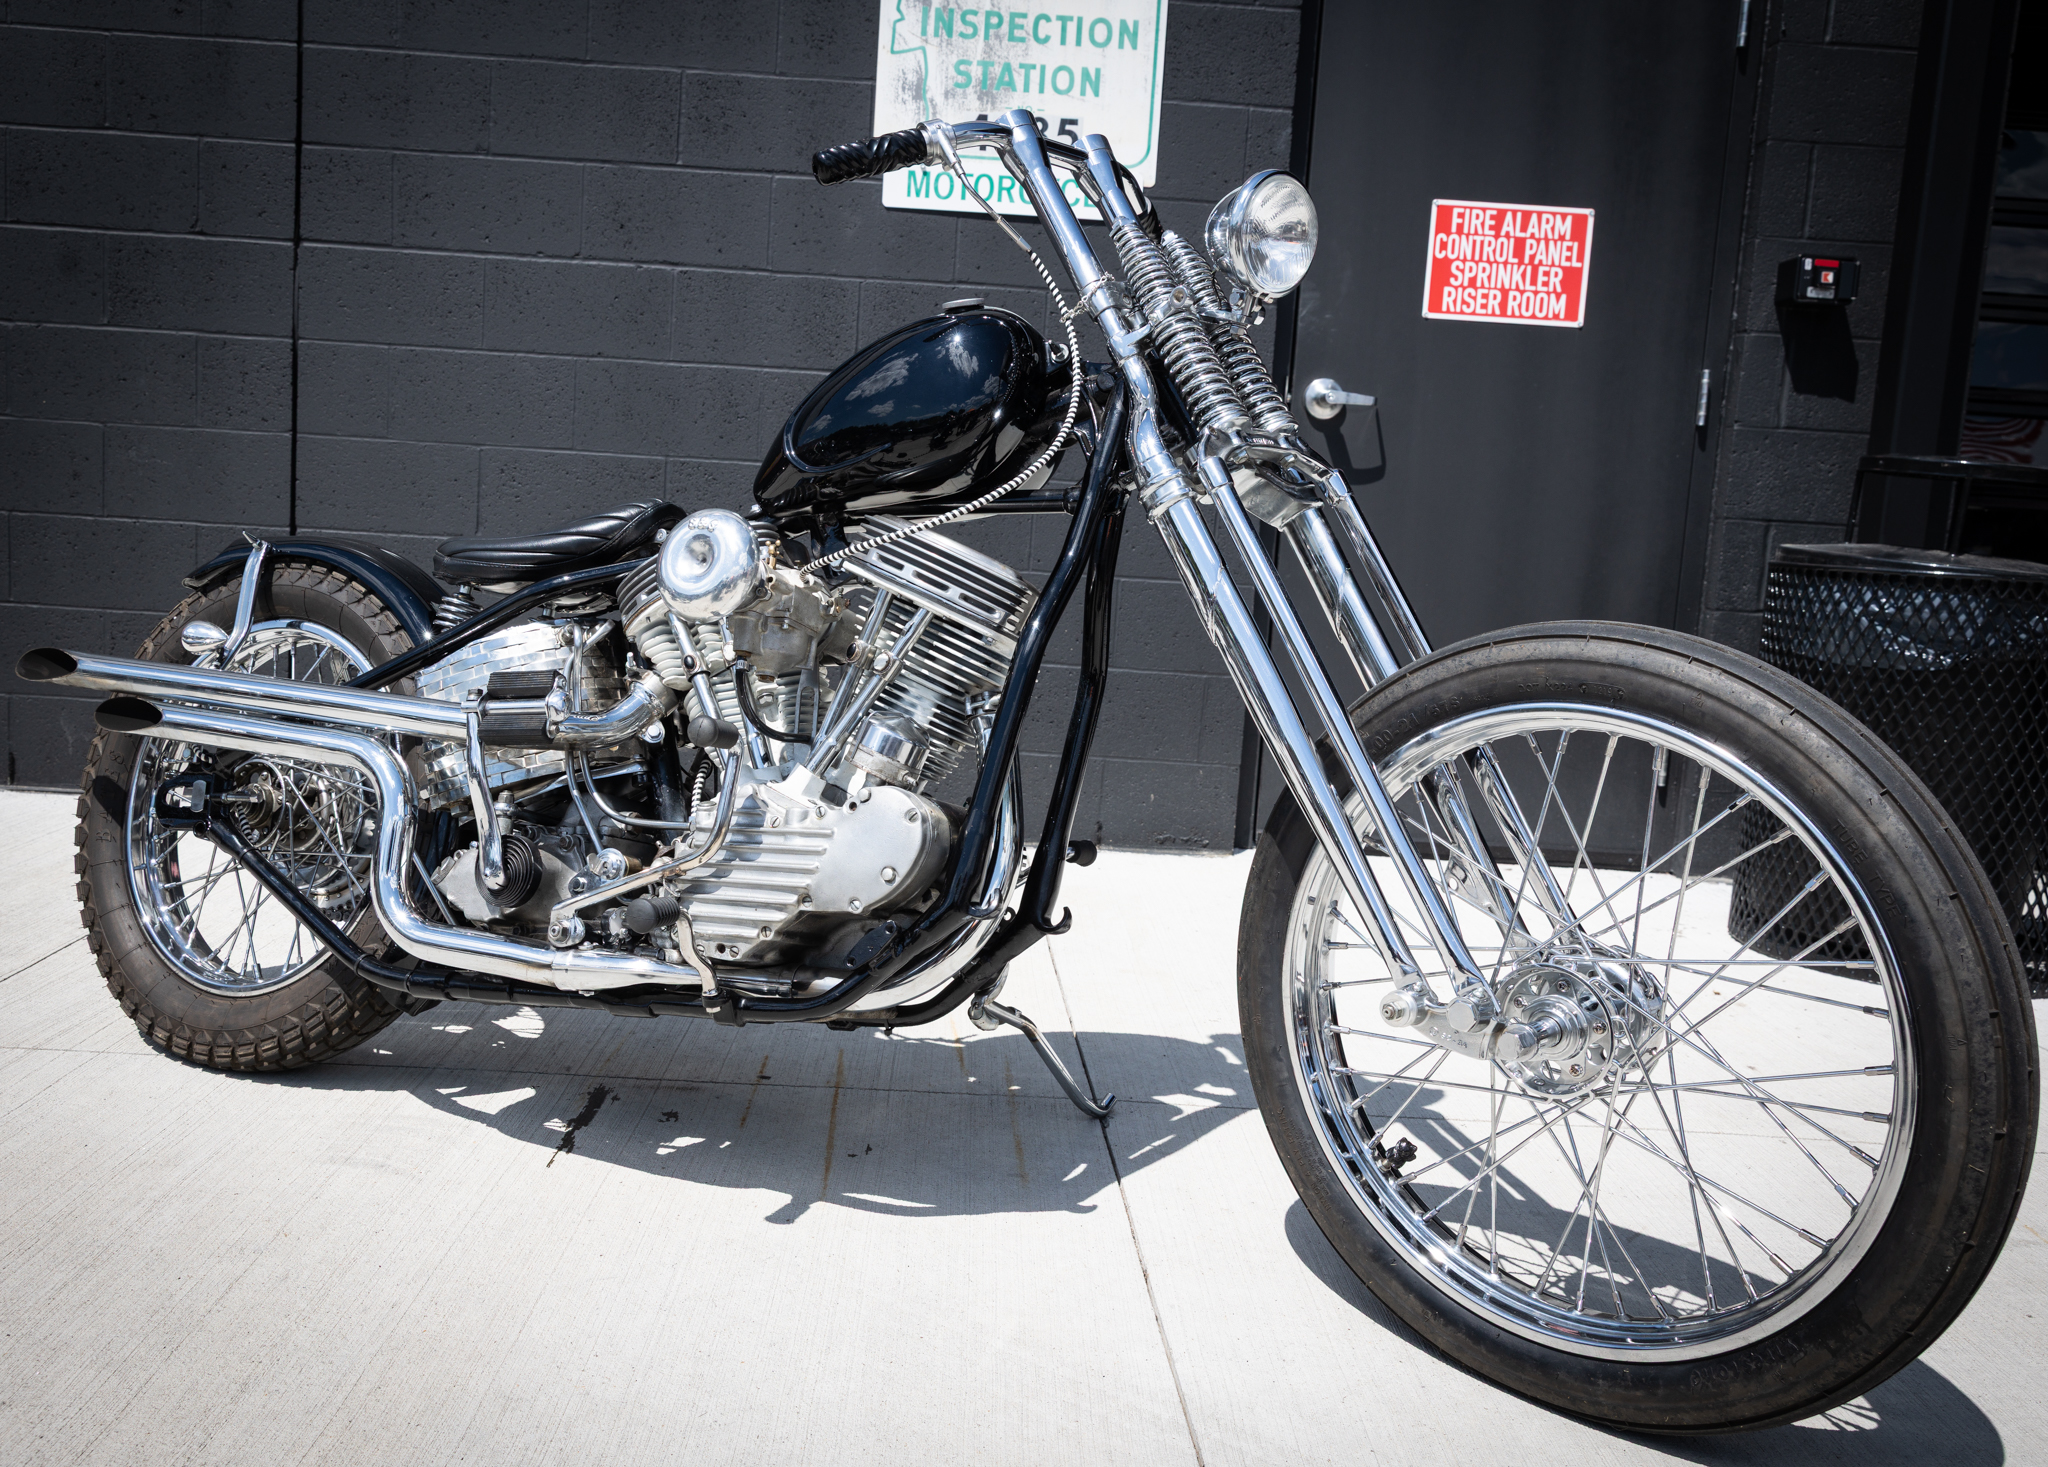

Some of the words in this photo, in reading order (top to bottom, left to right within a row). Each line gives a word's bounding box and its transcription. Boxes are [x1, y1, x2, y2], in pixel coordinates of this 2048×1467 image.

[920, 6, 1139, 50] INSPECTION
[953, 58, 1101, 98] STATION
[1451, 207, 1497, 236] FIRE
[1500, 211, 1572, 240] ALARM
[1434, 232, 1519, 264] CONTROL
[1524, 238, 1582, 268] PANEL
[1449, 260, 1563, 293] SPRINKLER
[1441, 286, 1502, 315] RISER
[1506, 290, 1567, 319] ROOM
[1831, 818, 1869, 866] TUBE
[1868, 870, 1902, 918] TYPE
